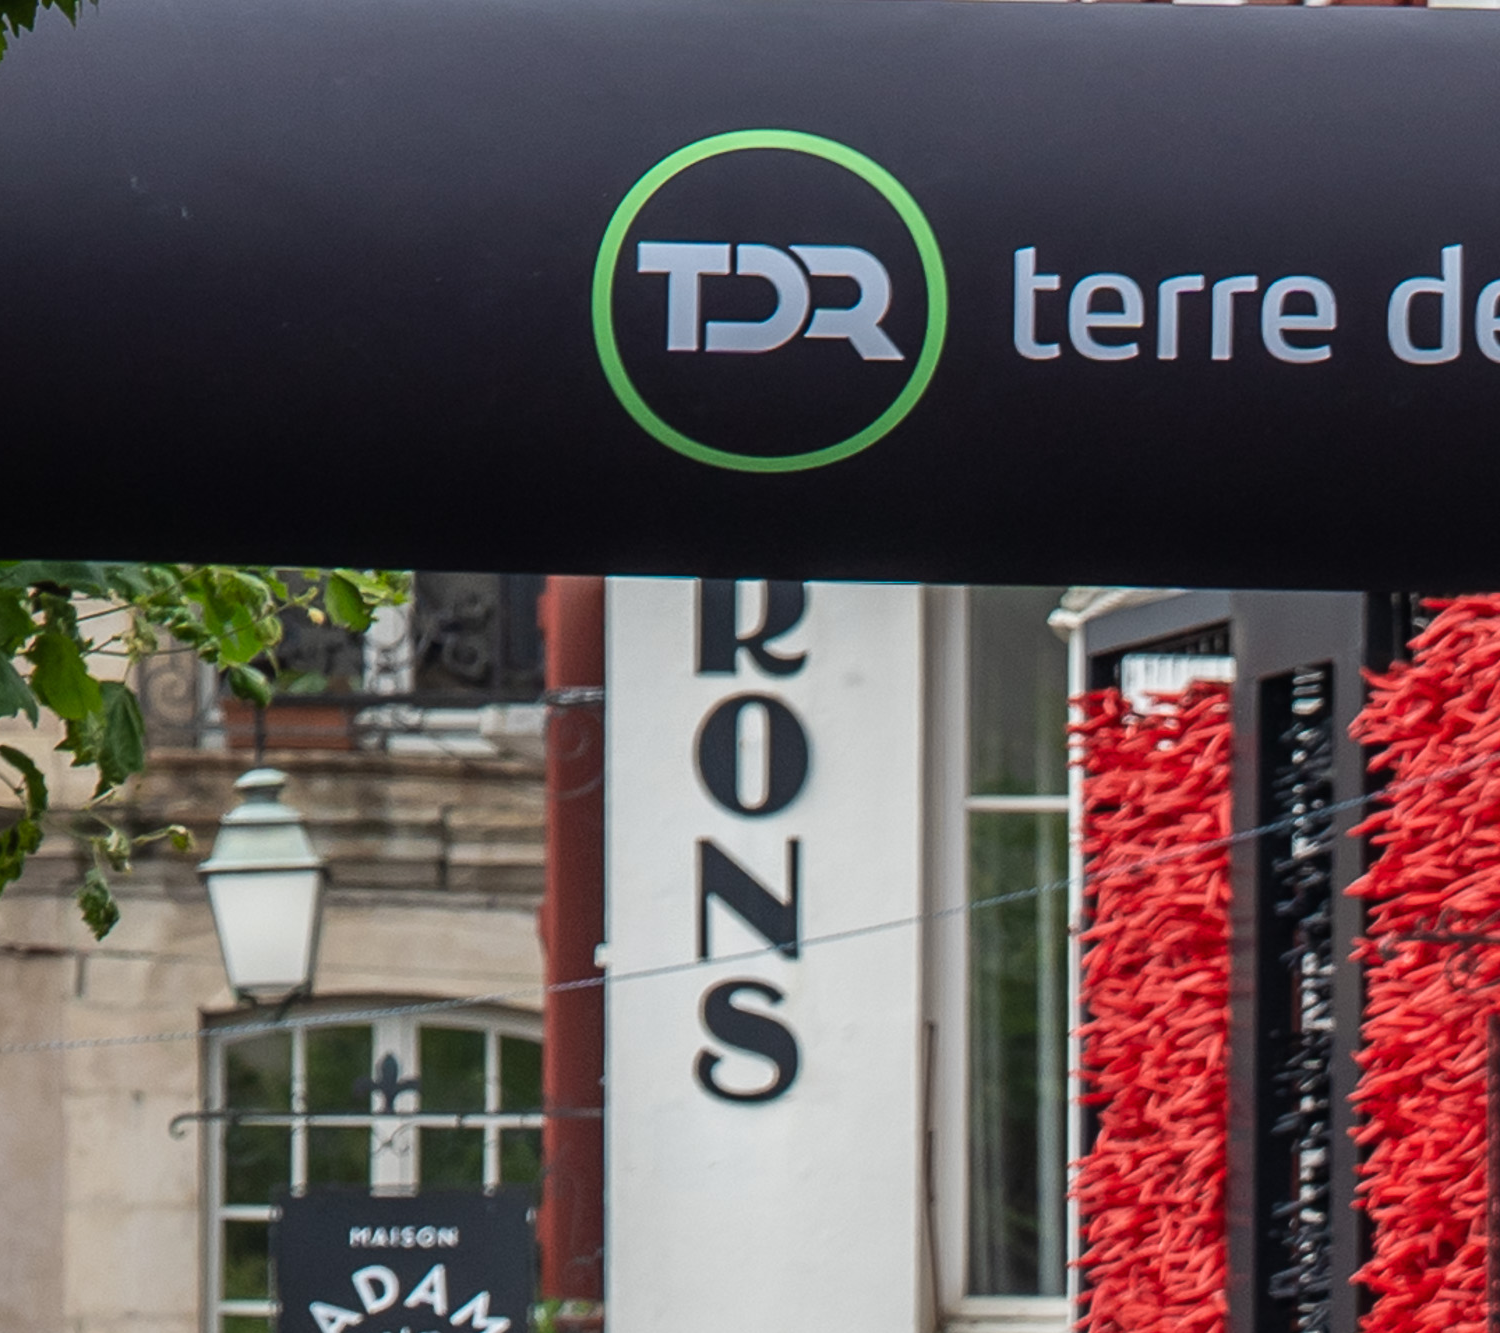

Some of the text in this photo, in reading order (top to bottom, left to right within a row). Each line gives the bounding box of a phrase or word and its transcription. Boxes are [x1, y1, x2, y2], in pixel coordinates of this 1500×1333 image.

[637, 241, 905, 361] TDR
[1014, 245, 1340, 363] terre
[349, 1226, 457, 1247] MAISON
